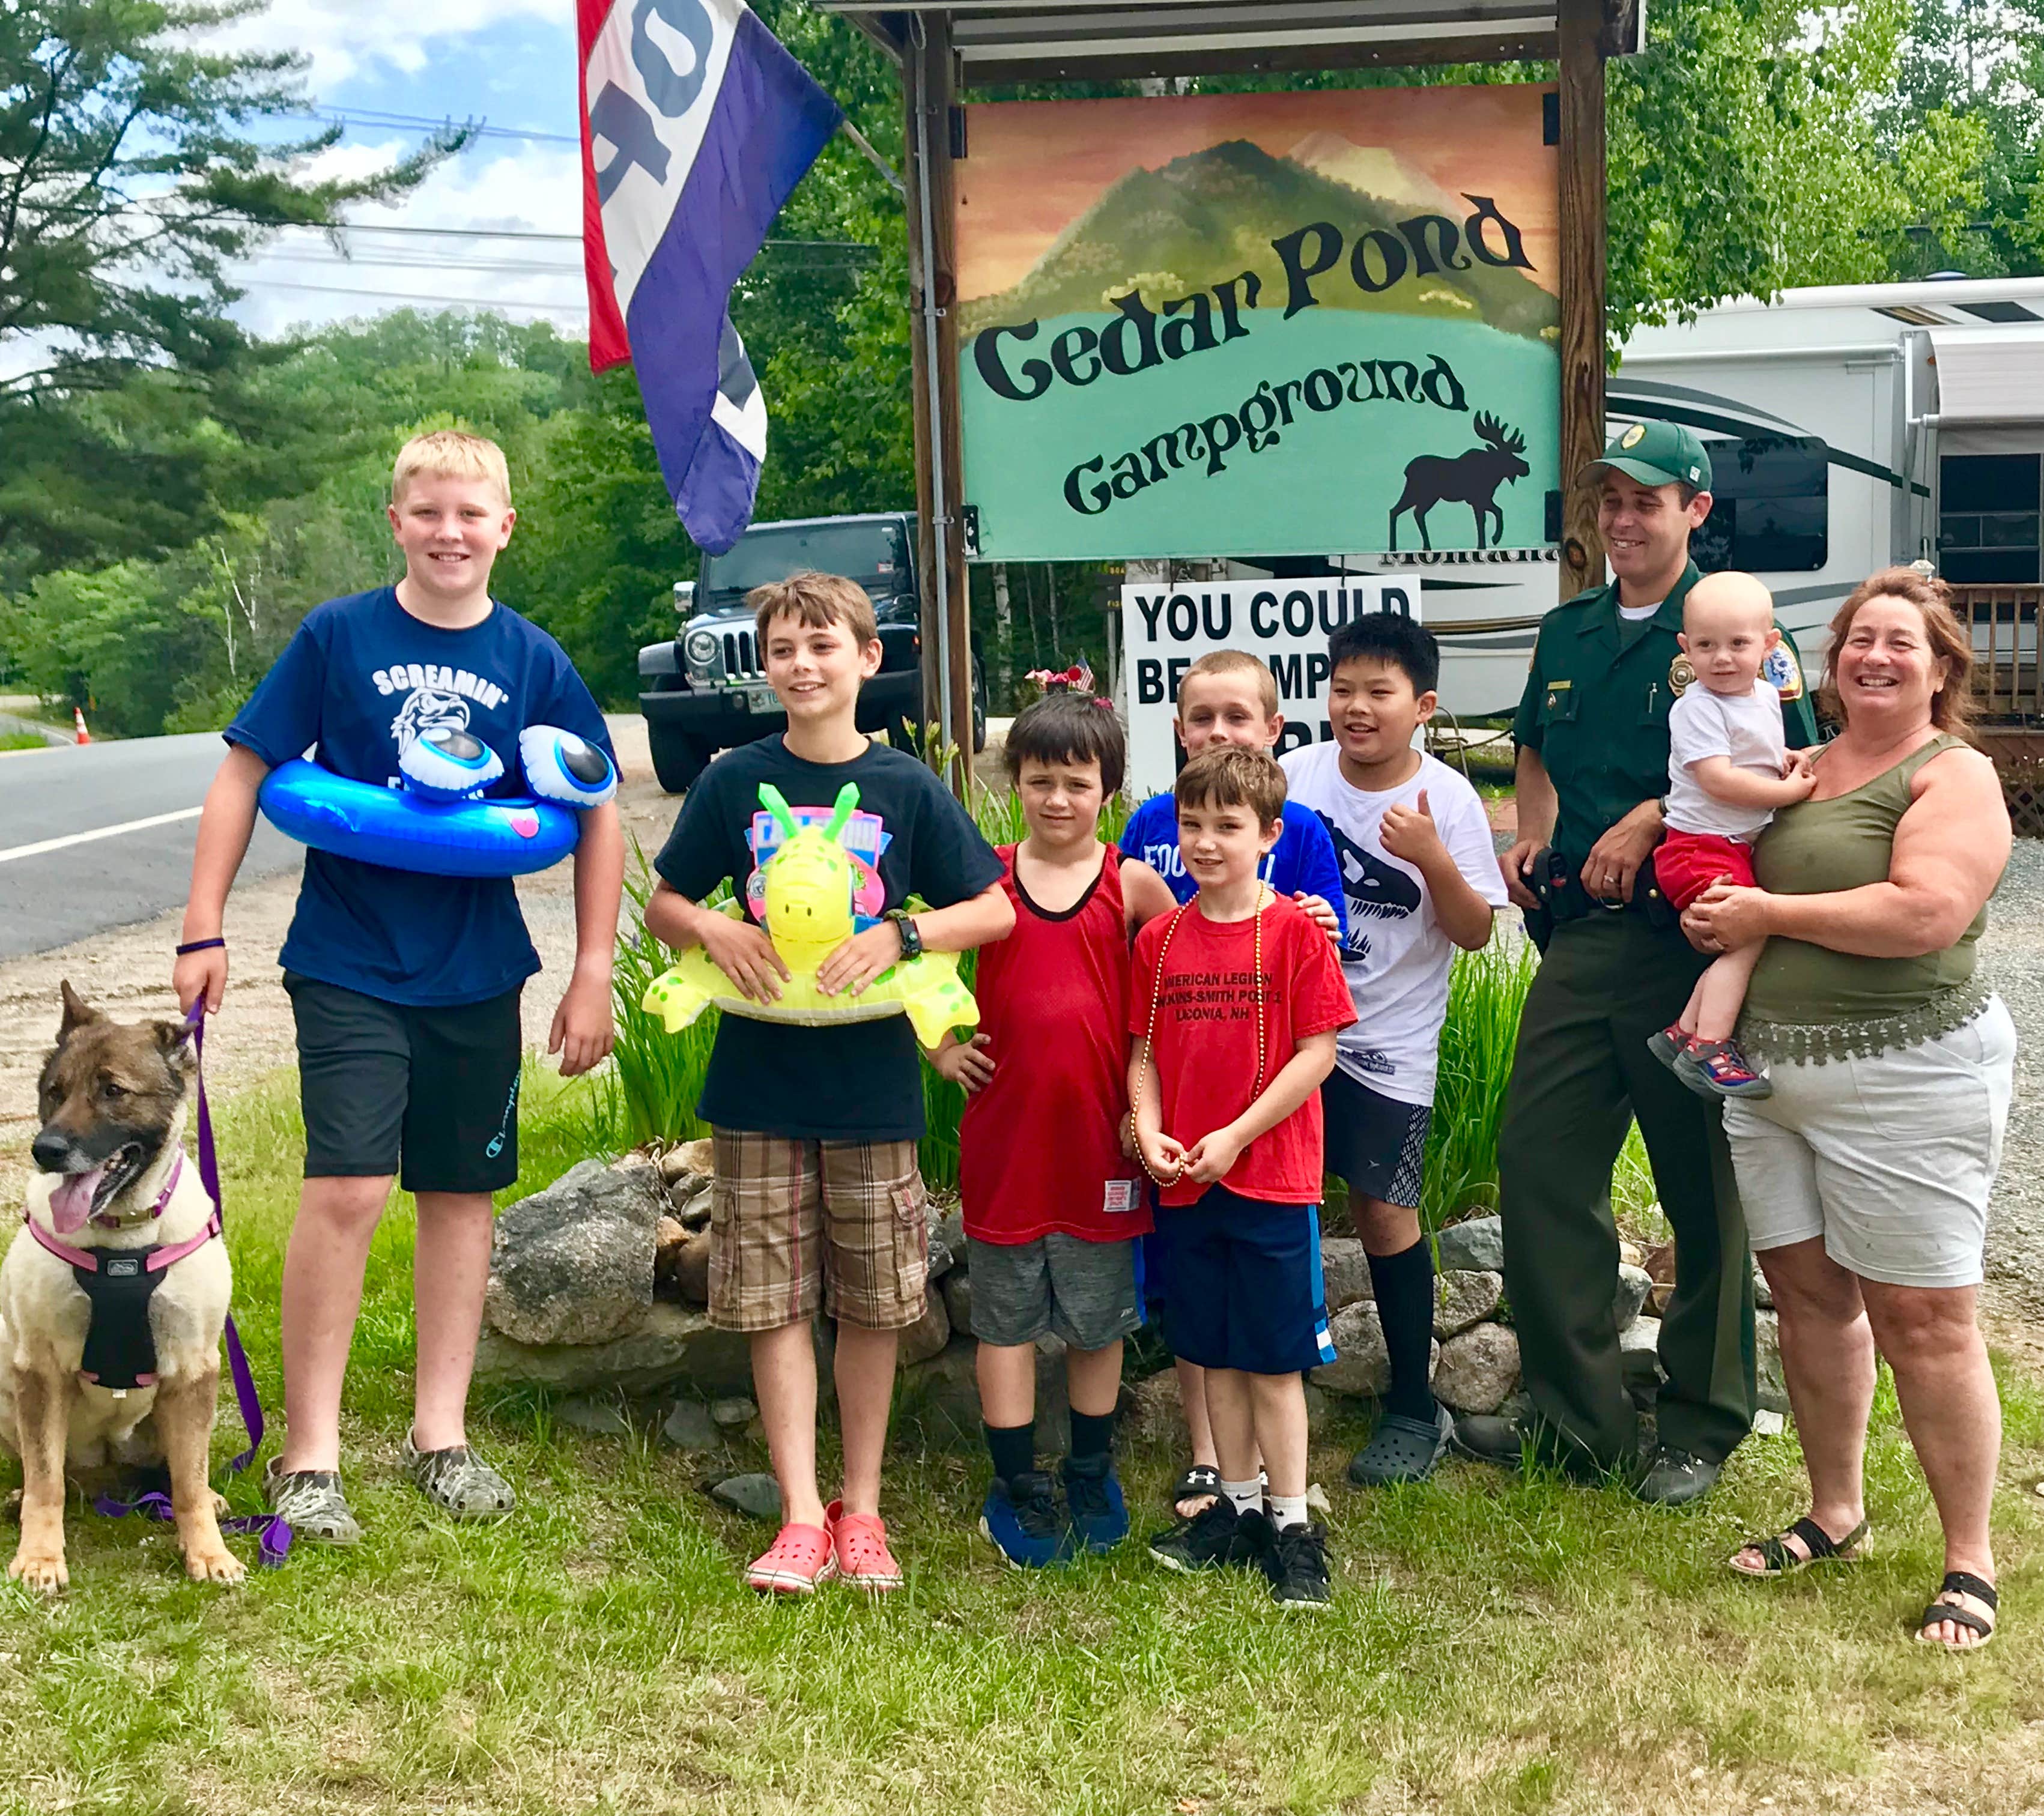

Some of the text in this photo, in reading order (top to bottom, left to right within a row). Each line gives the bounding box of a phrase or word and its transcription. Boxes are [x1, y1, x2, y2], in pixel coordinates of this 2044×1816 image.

[974, 192, 1538, 401] Cedar Pond
[1063, 353, 1469, 515] Campground
[1135, 593, 1231, 642] YOU
[372, 664, 509, 710] SCREAMIN'
[1164, 973, 1220, 990] MERICAN
[1230, 1007, 1250, 1020] NH
